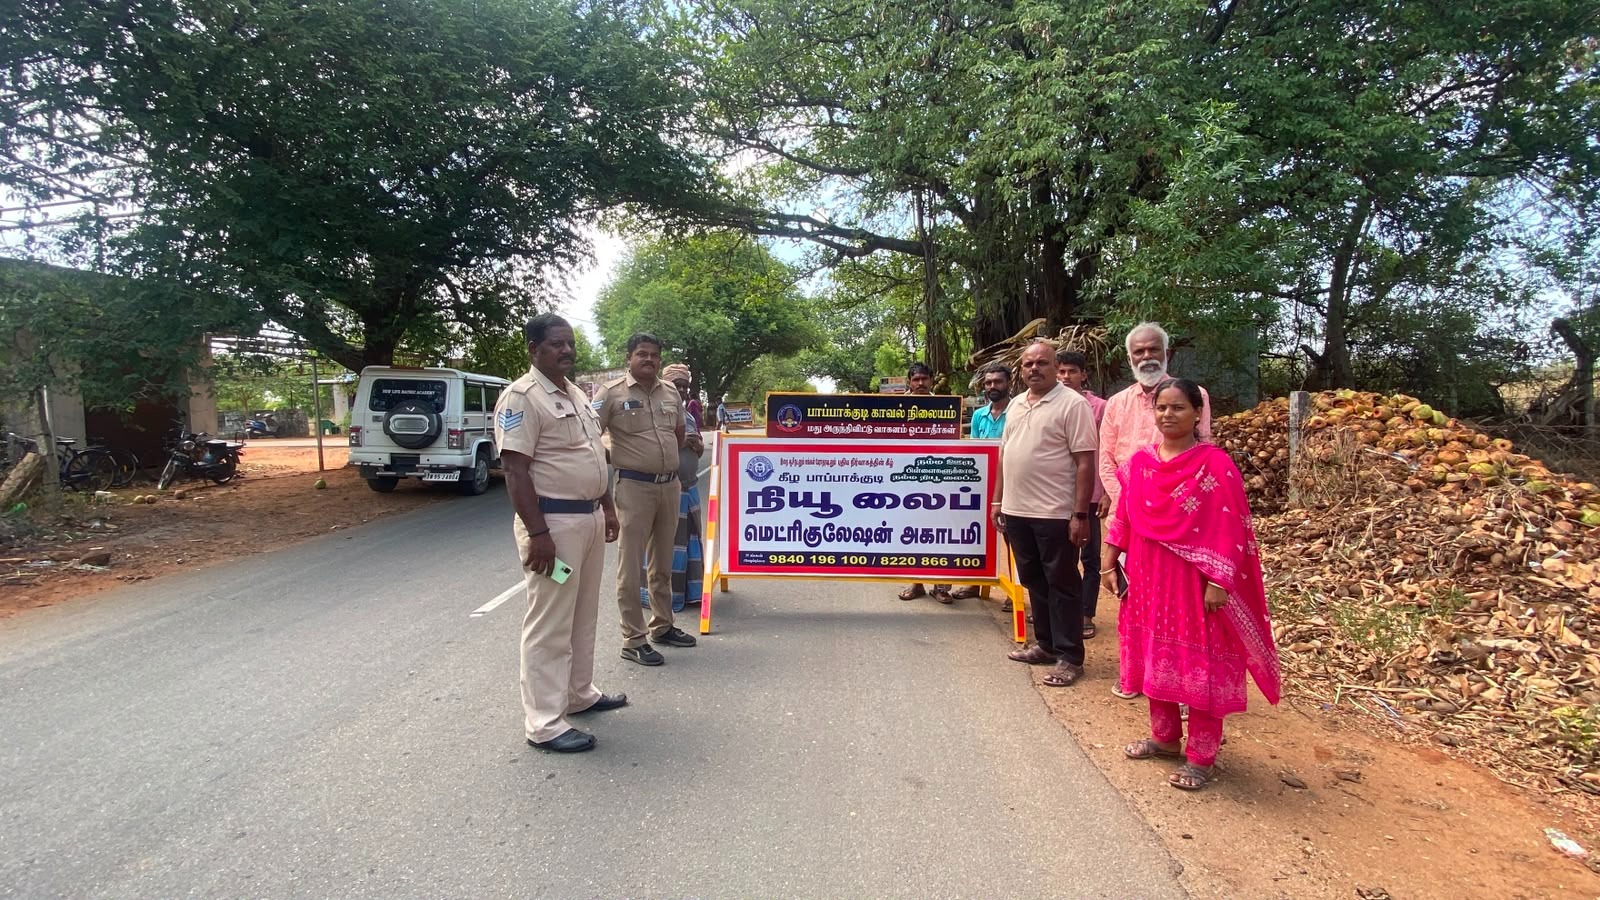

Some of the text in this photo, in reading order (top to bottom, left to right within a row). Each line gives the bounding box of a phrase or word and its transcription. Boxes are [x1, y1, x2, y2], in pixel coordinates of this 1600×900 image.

[807, 403, 869, 421] பாப்பாக்குடி
[871, 404, 905, 419] காவல்
[907, 405, 957, 422] நிலையம்
[807, 425, 822, 434] மது
[823, 423, 873, 435] அருந்திவிட்டு
[873, 425, 907, 434] வாகனம்
[916, 458, 944, 466] நம்ம
[778, 472, 884, 484] கீழ பாப்பாக்குடி
[891, 473, 918, 481] நம்ம
[745, 485, 981, 518] நியூ லைப்
[744, 519, 981, 548] மெட்ரிகுலேஷன் அகாடமி
[769, 554, 804, 565] 9840
[809, 555, 836, 565] 196
[841, 555, 868, 566] 100
[871, 556, 876, 566] /
[880, 556, 917, 567] 8220
[921, 557, 948, 567] 866
[953, 557, 981, 568] 100
